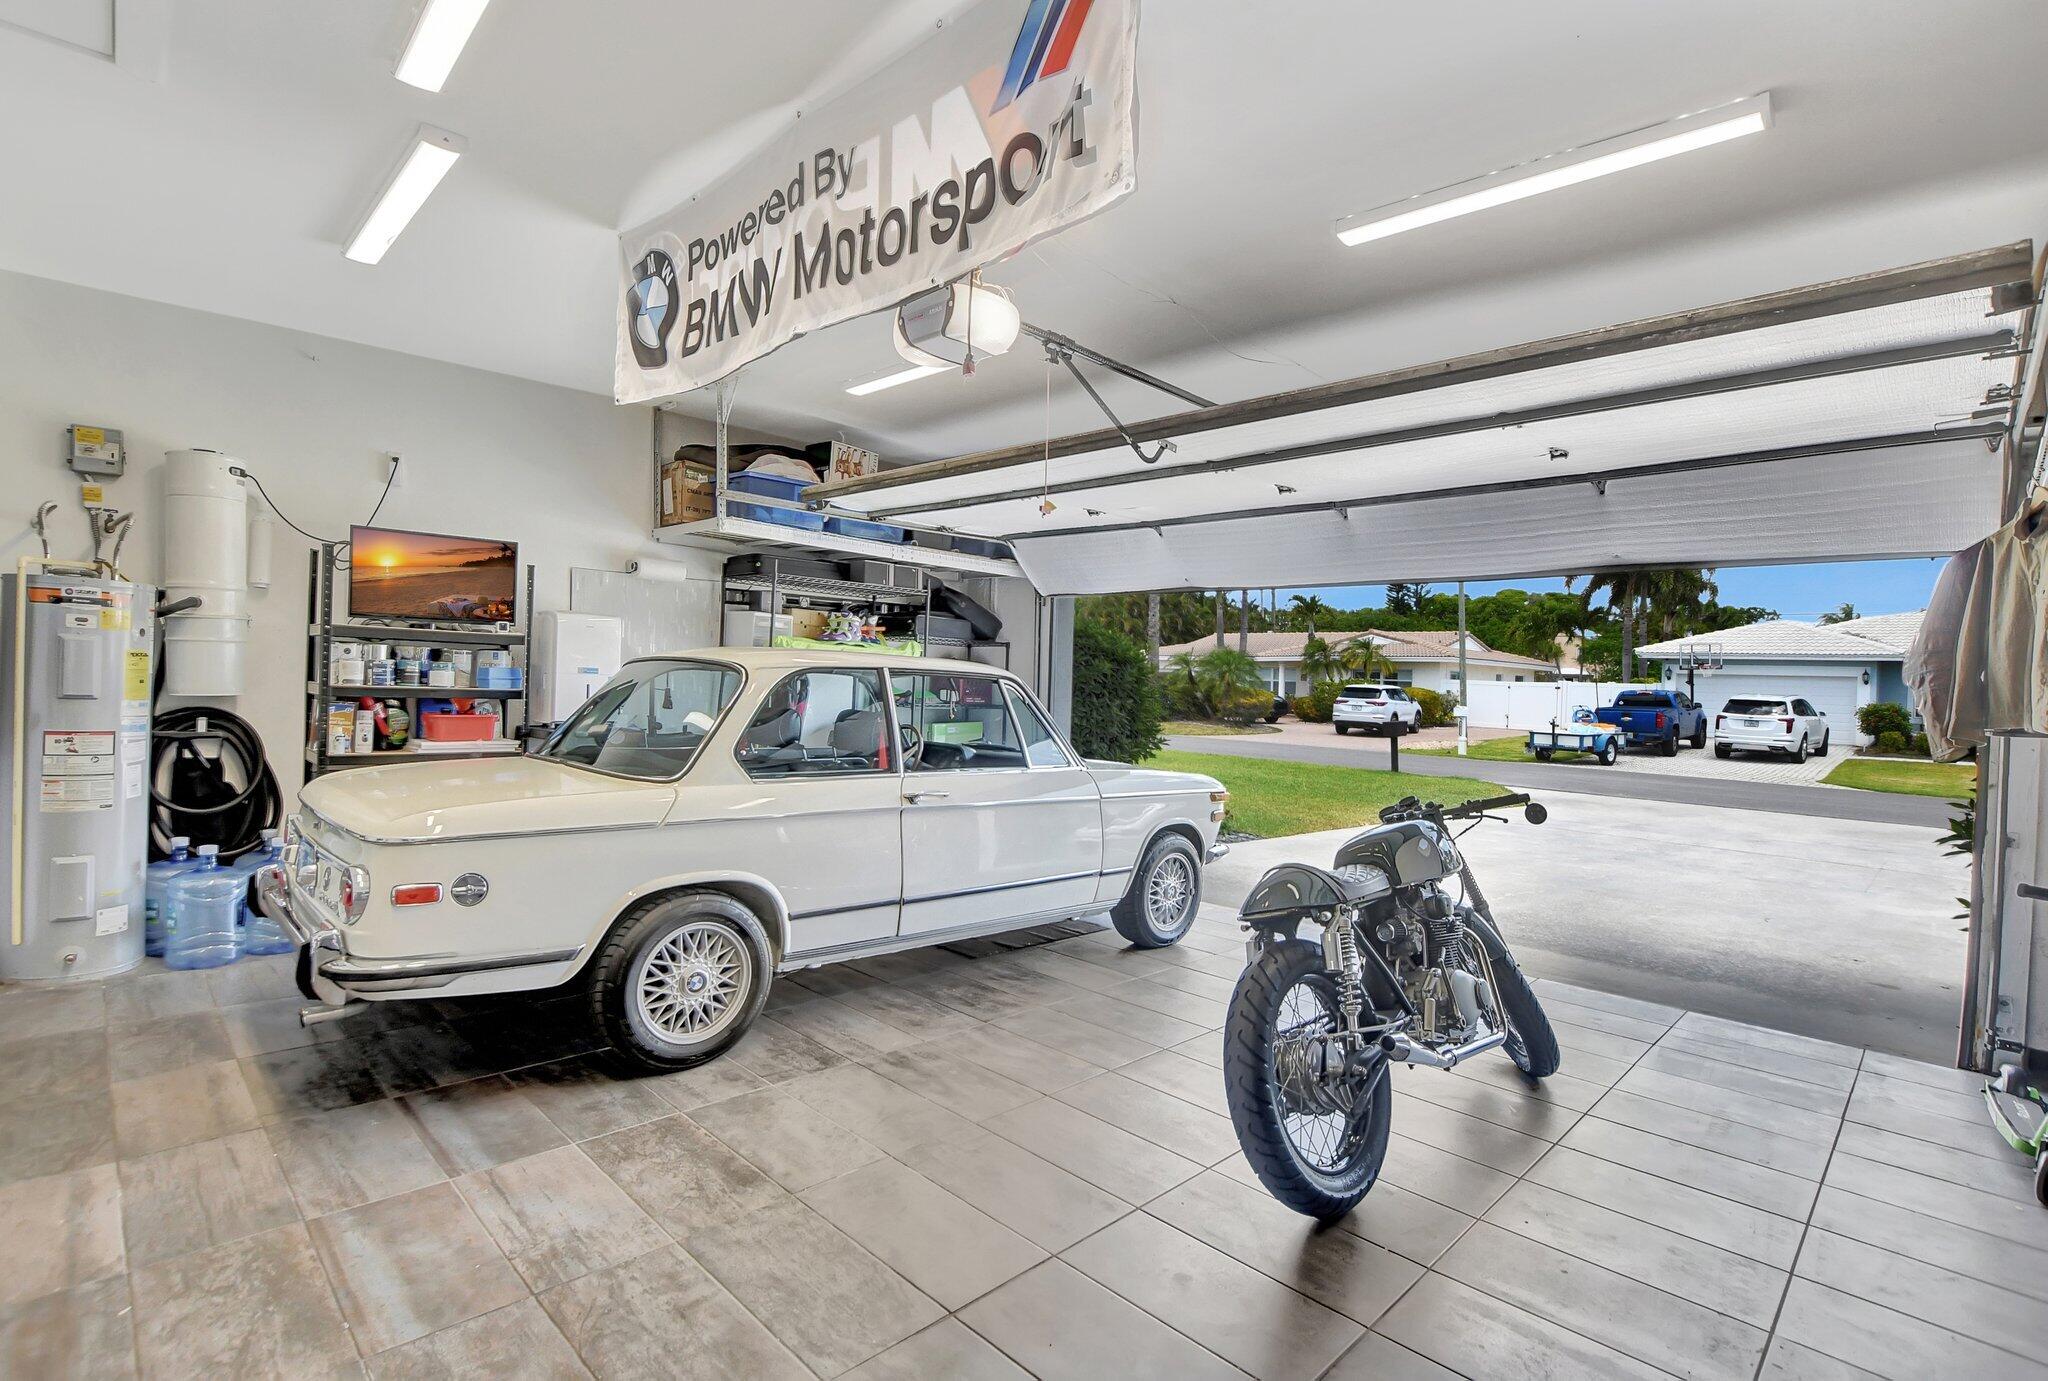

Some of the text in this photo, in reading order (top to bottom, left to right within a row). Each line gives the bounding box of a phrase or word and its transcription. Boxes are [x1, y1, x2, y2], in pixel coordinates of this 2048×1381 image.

[682, 76, 1098, 358] BMW Motorsport
[688, 145, 858, 283] Powered By
